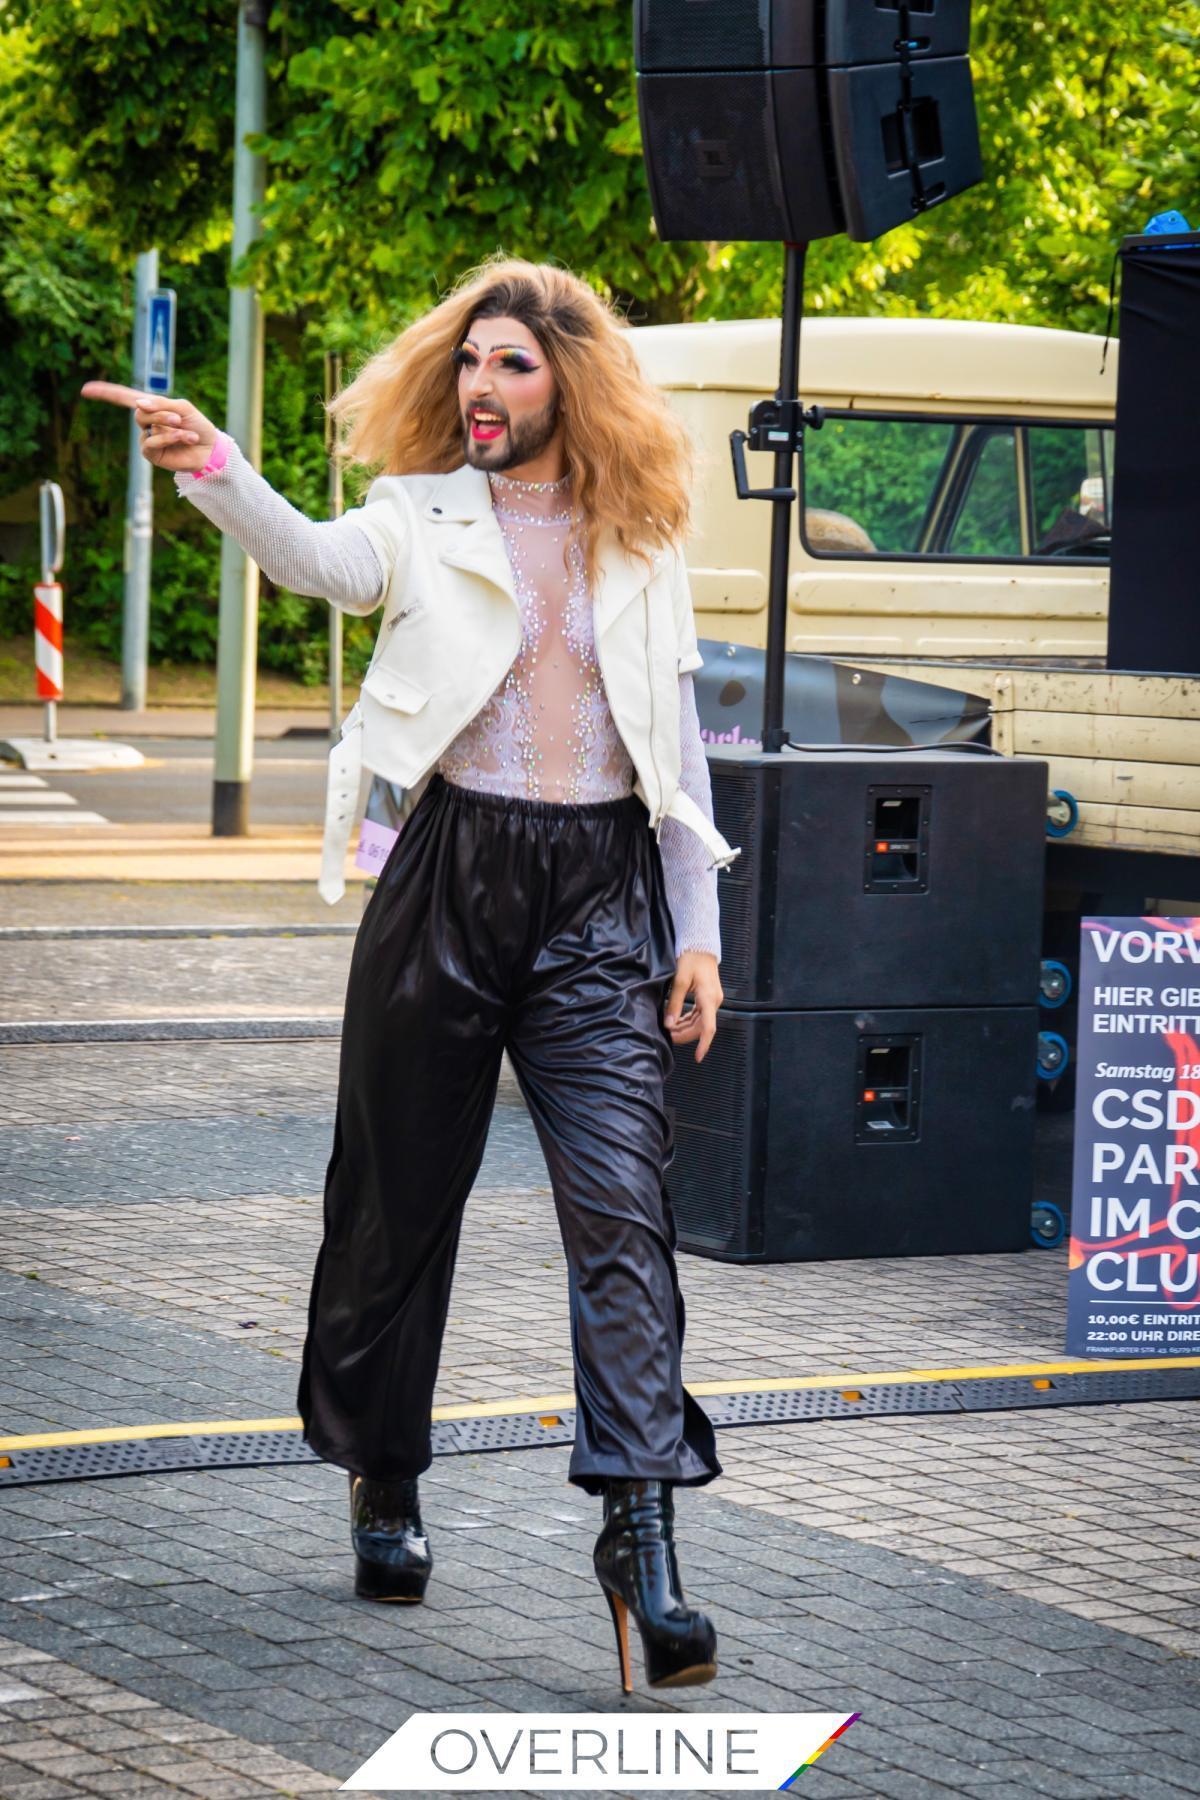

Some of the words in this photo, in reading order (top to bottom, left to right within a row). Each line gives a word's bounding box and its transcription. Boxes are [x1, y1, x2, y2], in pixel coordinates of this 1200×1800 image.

[1093, 986, 1154, 1007] HIER
[1160, 987, 1200, 1007] GIB
[1093, 1013, 1200, 1035] EINTRITT
[1095, 1062, 1176, 1082] Samstag
[1092, 1088, 1200, 1131] CSD
[1092, 1142, 1200, 1186] PAR
[1090, 1197, 1151, 1239] IM
[1086, 1251, 1198, 1293] CLU
[1088, 1314, 1140, 1325] 10,00€
[1143, 1314, 1200, 1325] EINTRIT
[1087, 1331, 1128, 1341] 22:00
[1131, 1330, 1164, 1341] UHR
[1167, 1330, 1200, 1341] DIRE
